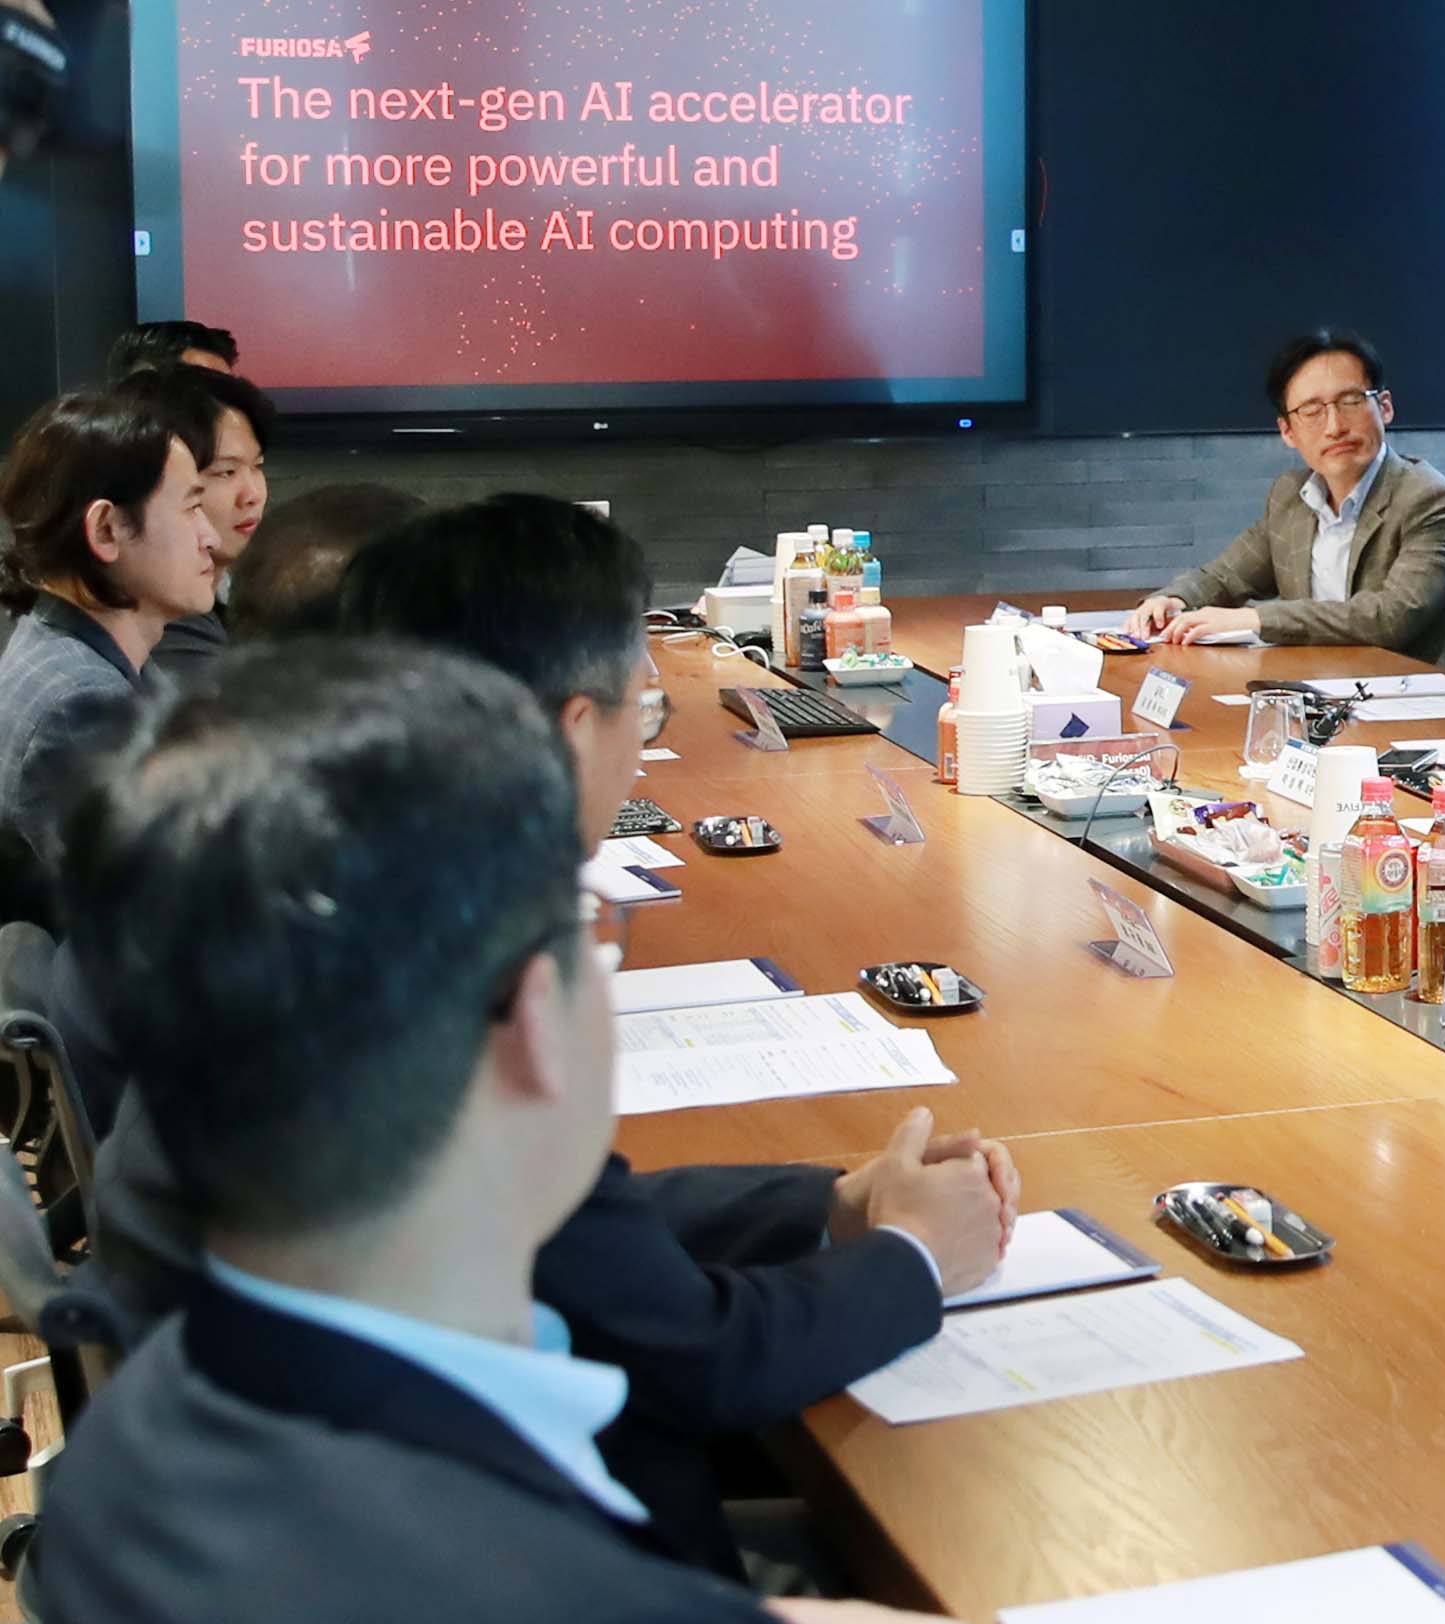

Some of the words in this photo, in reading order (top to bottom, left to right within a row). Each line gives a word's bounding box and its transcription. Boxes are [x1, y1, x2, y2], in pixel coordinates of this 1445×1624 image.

[240, 37, 345, 58] FURIOSA
[238, 75, 332, 120] The
[349, 81, 566, 132] next-gen
[580, 81, 633, 122] AI
[648, 81, 912, 124] accelerator
[240, 142, 311, 186] for
[326, 154, 453, 187] more
[468, 144, 680, 197] powerful
[693, 144, 780, 187] and
[243, 207, 528, 252] sustainable
[541, 209, 594, 251] AI
[609, 208, 859, 260] computing
